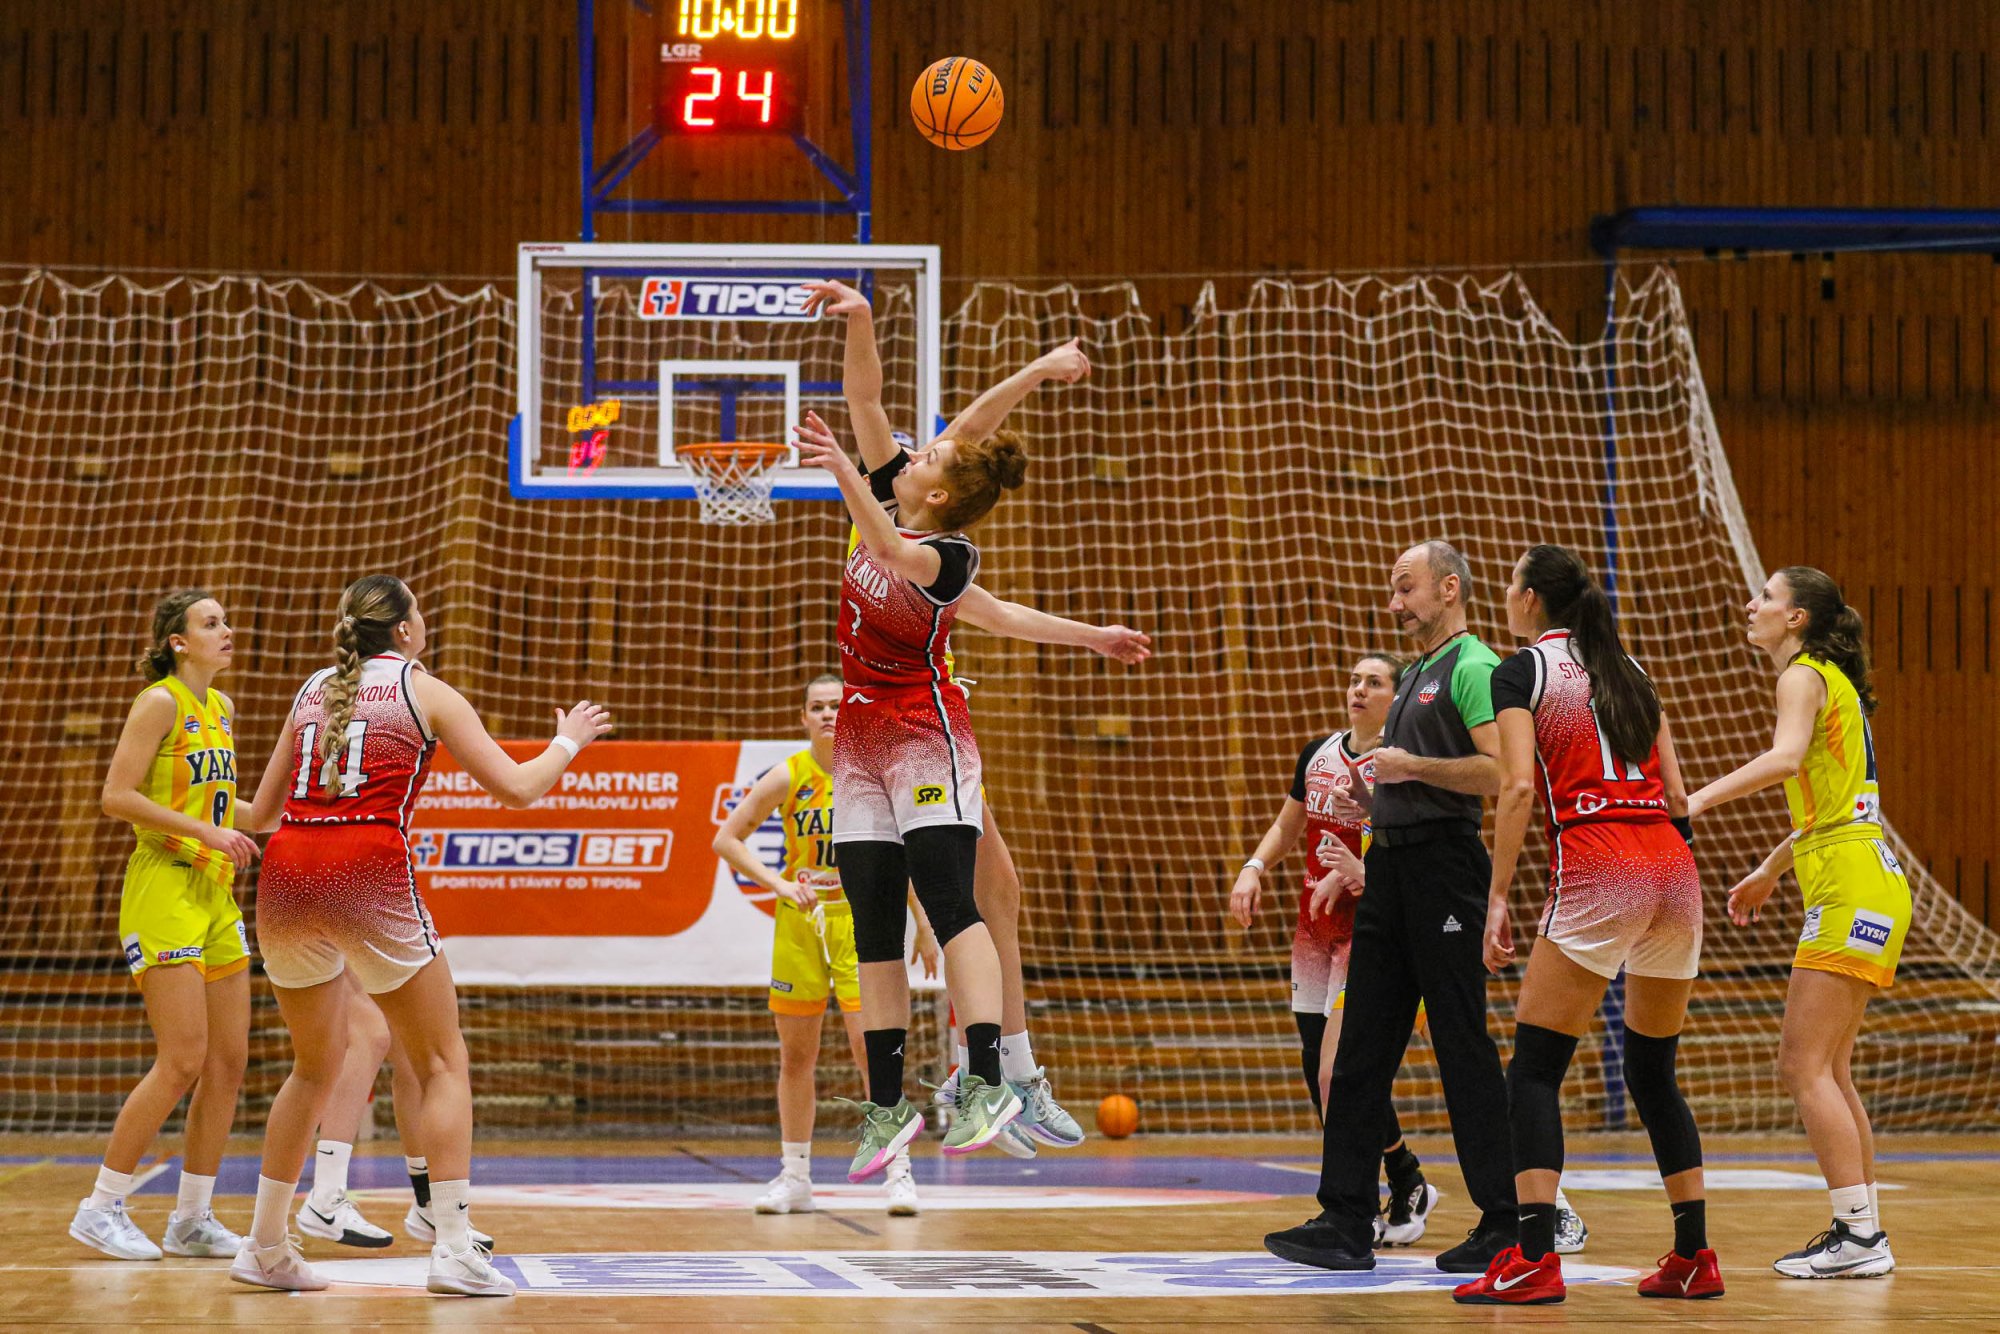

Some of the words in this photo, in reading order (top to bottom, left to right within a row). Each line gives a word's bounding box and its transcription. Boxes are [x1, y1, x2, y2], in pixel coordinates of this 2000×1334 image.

[661, 44, 702, 58] LGR
[684, 67, 772, 125] 24
[692, 284, 814, 315] TIPOS
[1558, 662, 1588, 681] STR
[186, 748, 237, 785] YAK
[293, 720, 370, 800] 14
[562, 772, 679, 792] PARTNER
[642, 797, 679, 810] LIGY
[917, 787, 943, 804] SPP
[1306, 791, 1337, 817] SLÁ
[453, 836, 572, 865] TIPOS
[584, 836, 665, 865] BET
[430, 875, 506, 890] ŠPORTOVÉ
[509, 875, 562, 890] STÁVKY
[565, 877, 589, 890] OD
[1859, 925, 1888, 942] JYSK
